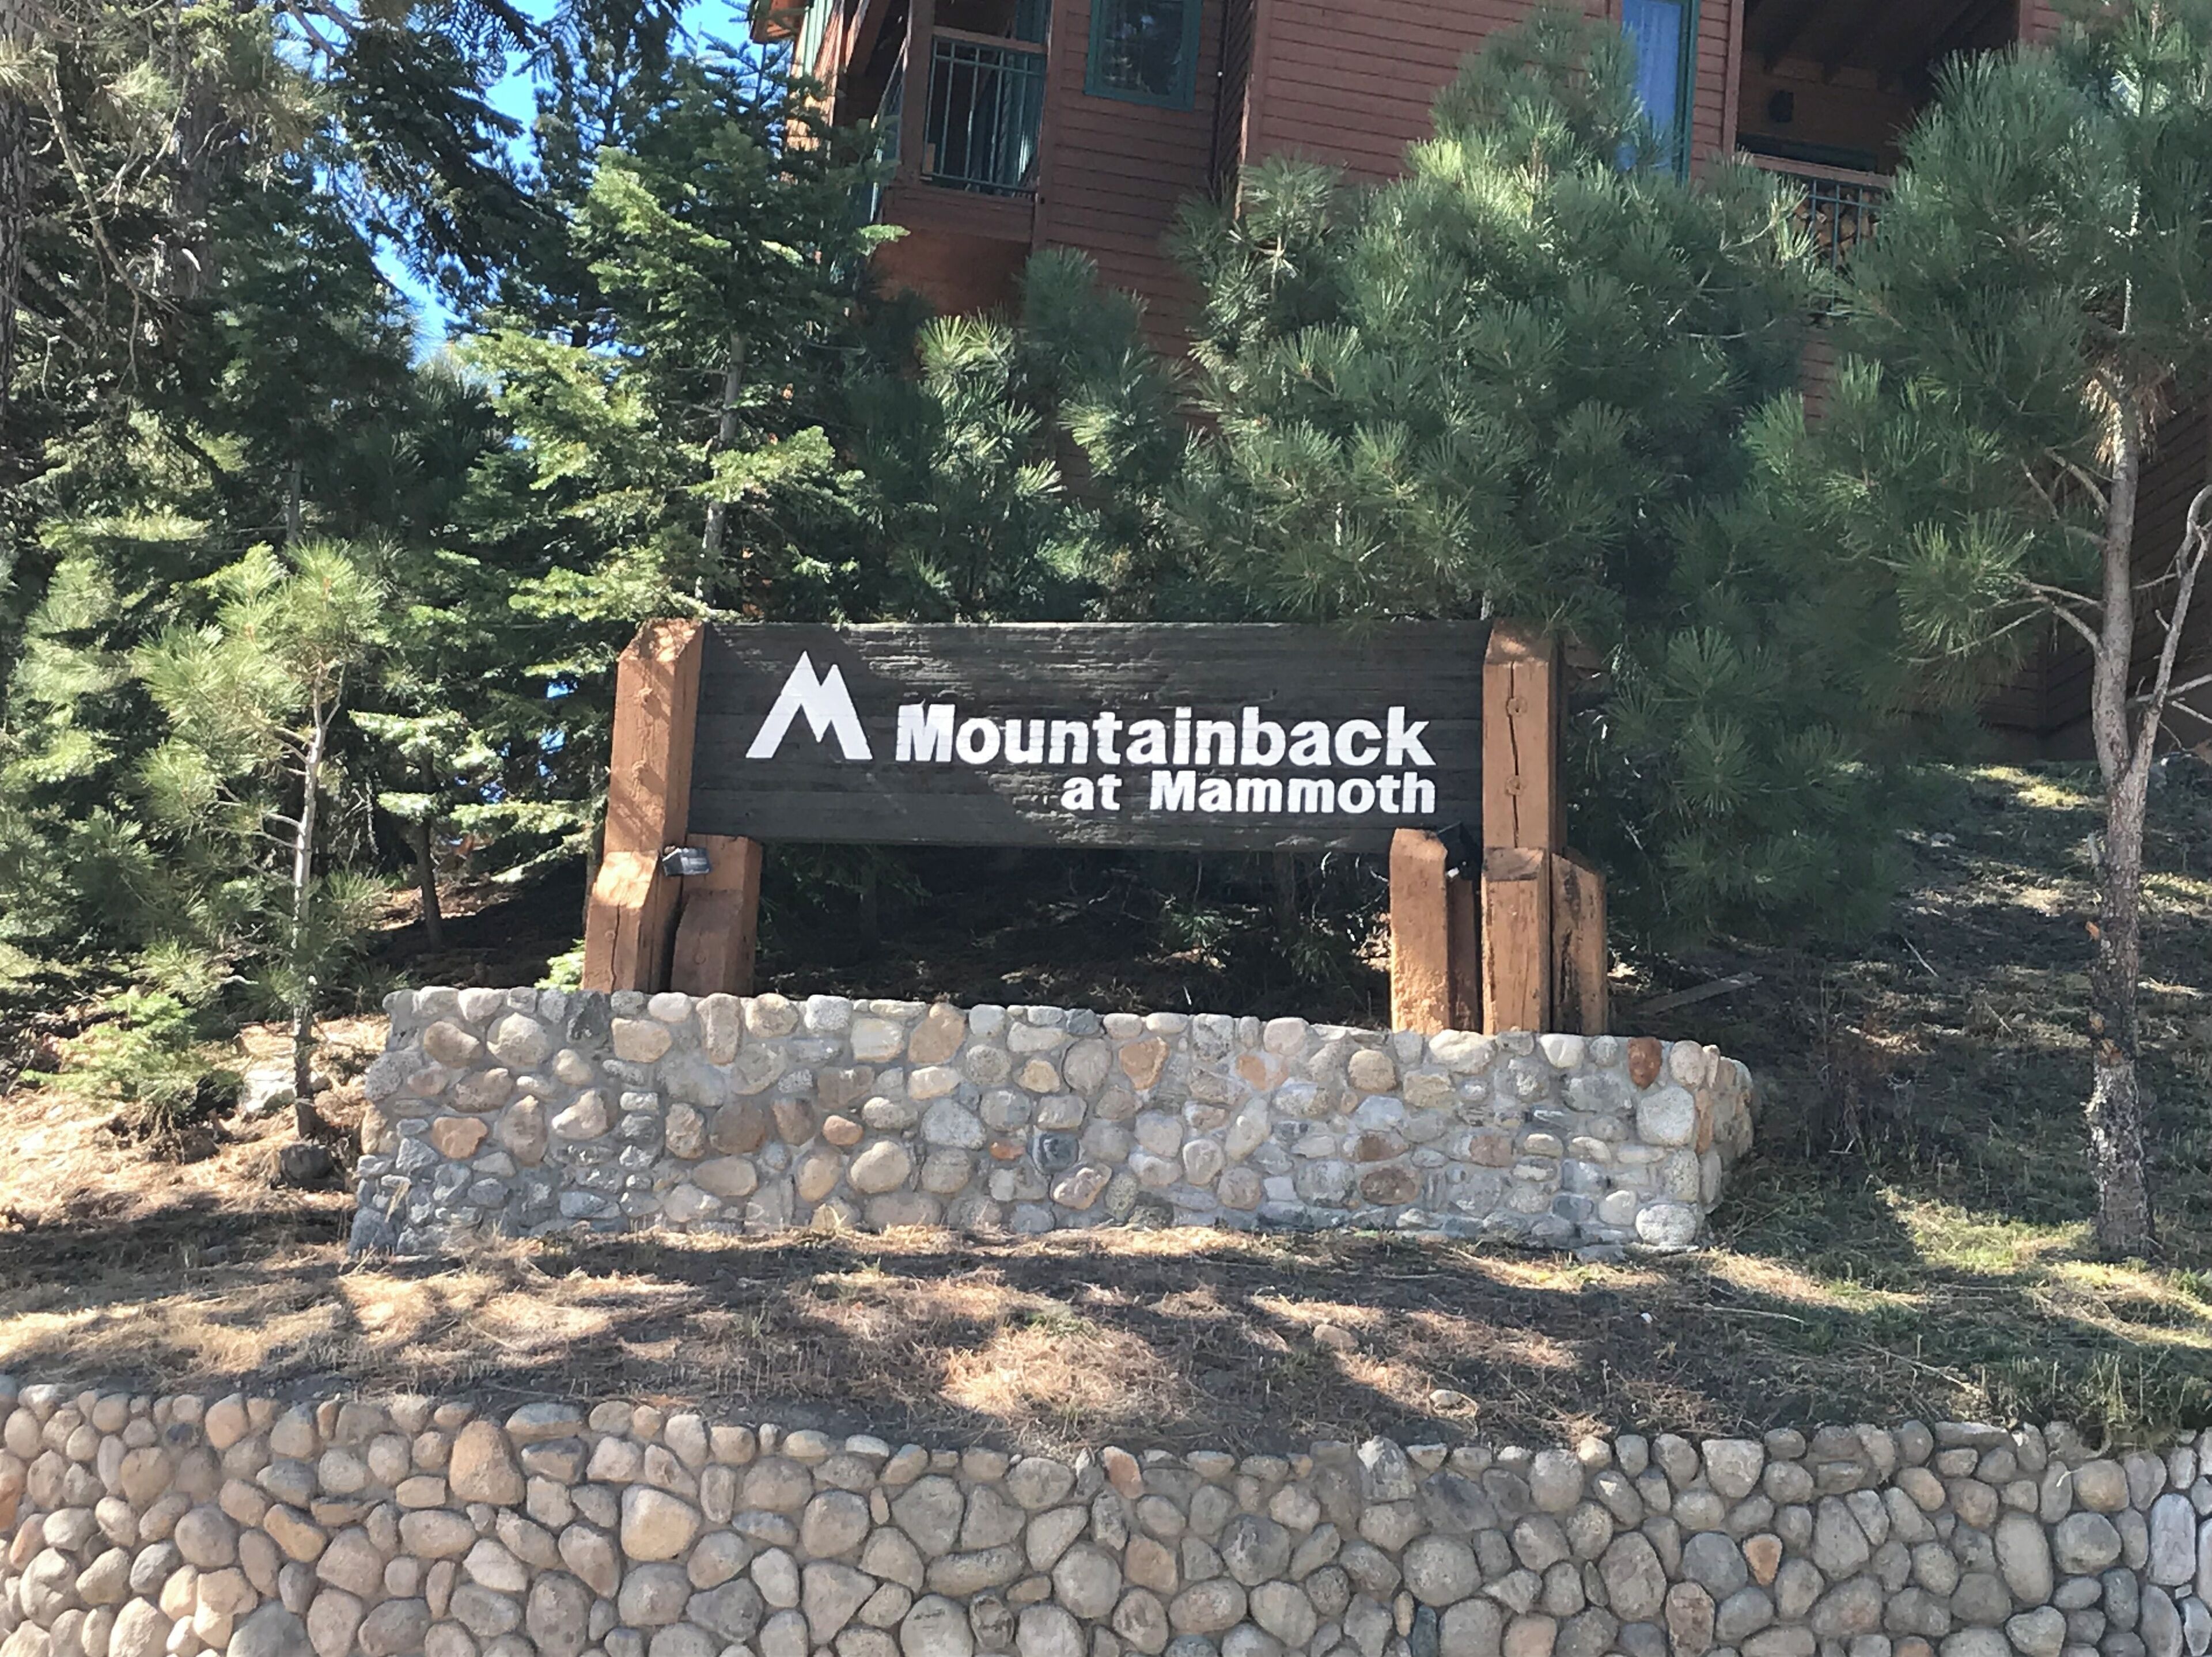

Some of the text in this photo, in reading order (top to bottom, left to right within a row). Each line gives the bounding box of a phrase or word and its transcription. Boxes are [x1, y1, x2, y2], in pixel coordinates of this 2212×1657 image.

[895, 704, 1436, 766] Mountainback
[1060, 771, 1435, 813] at Mammoth
